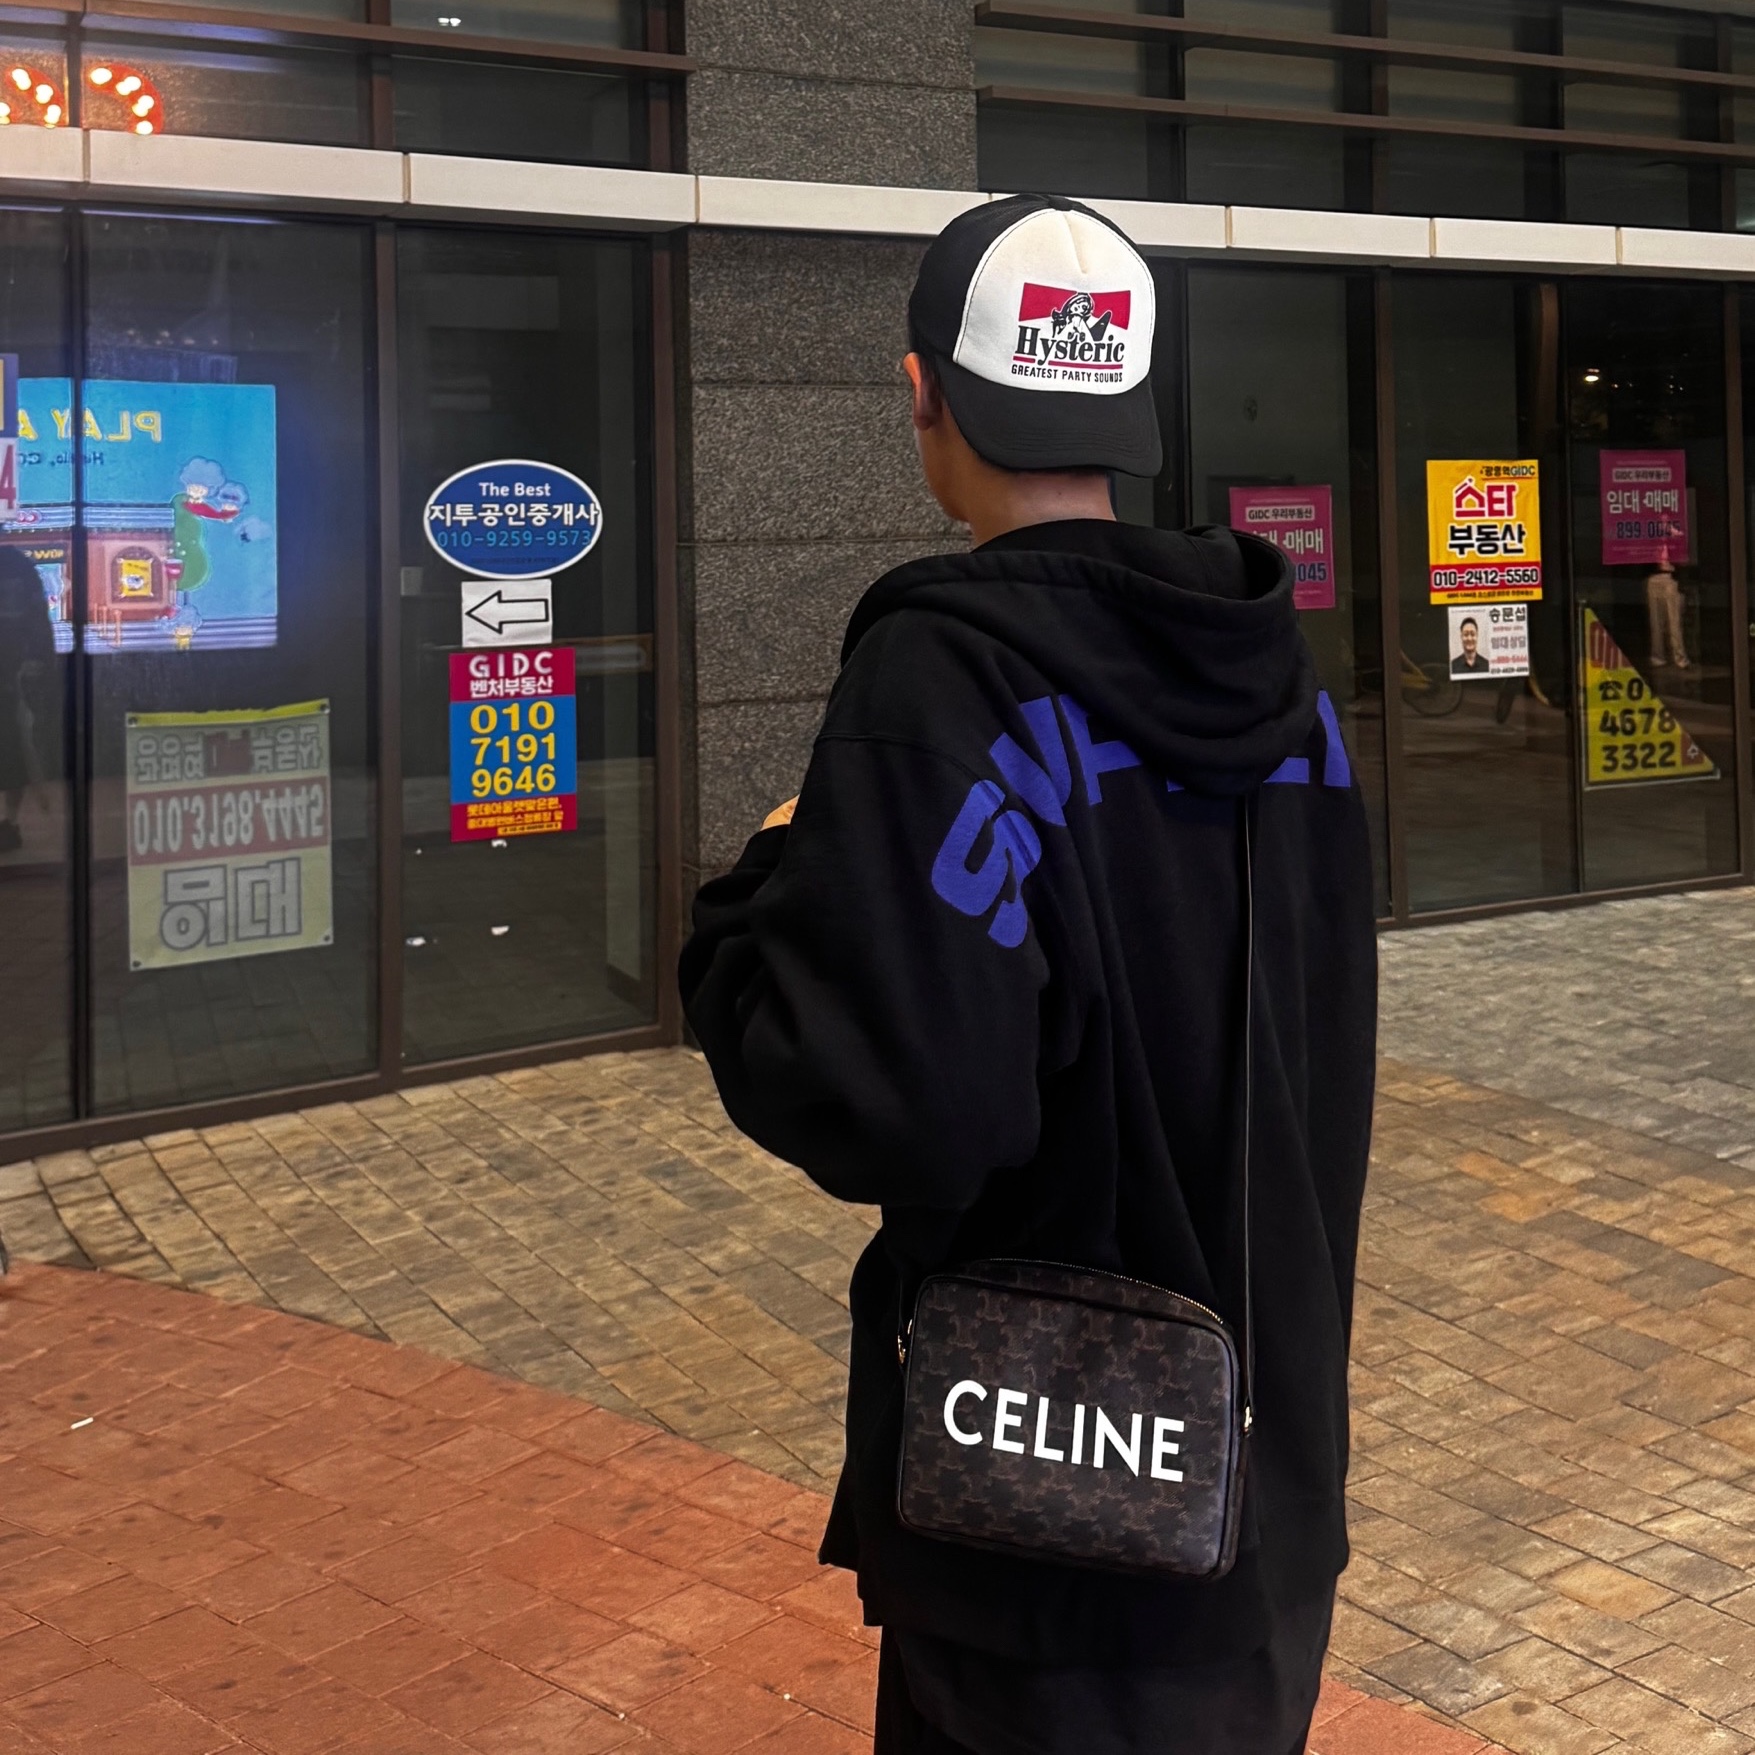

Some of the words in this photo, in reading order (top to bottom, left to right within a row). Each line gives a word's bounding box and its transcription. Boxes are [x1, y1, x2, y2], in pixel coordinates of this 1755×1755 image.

[1015, 325, 1125, 366] Hysteric
[1011, 364, 1059, 379] GREATEST
[1062, 370, 1091, 382] PARTY
[1094, 372, 1123, 383] SOUNDS
[479, 482, 510, 496] The
[514, 482, 551, 496] Best
[1455, 478, 1517, 518] 스타
[429, 502, 599, 527] 지투공인중개사
[1248, 509, 1270, 520] GIDC
[437, 530, 592, 547] 010-9259-9573
[1449, 524, 1525, 556] 부동산
[1433, 568, 1539, 587] 010-2412-5560
[469, 651, 553, 679] GIDC
[470, 676, 553, 698] 벤처부동산
[470, 701, 555, 734] 010
[1599, 707, 1677, 736] 4678
[471, 732, 555, 765] 7191
[1601, 741, 1676, 773] 3322
[471, 763, 556, 797] 9646
[944, 1380, 1185, 1483] CELINE
